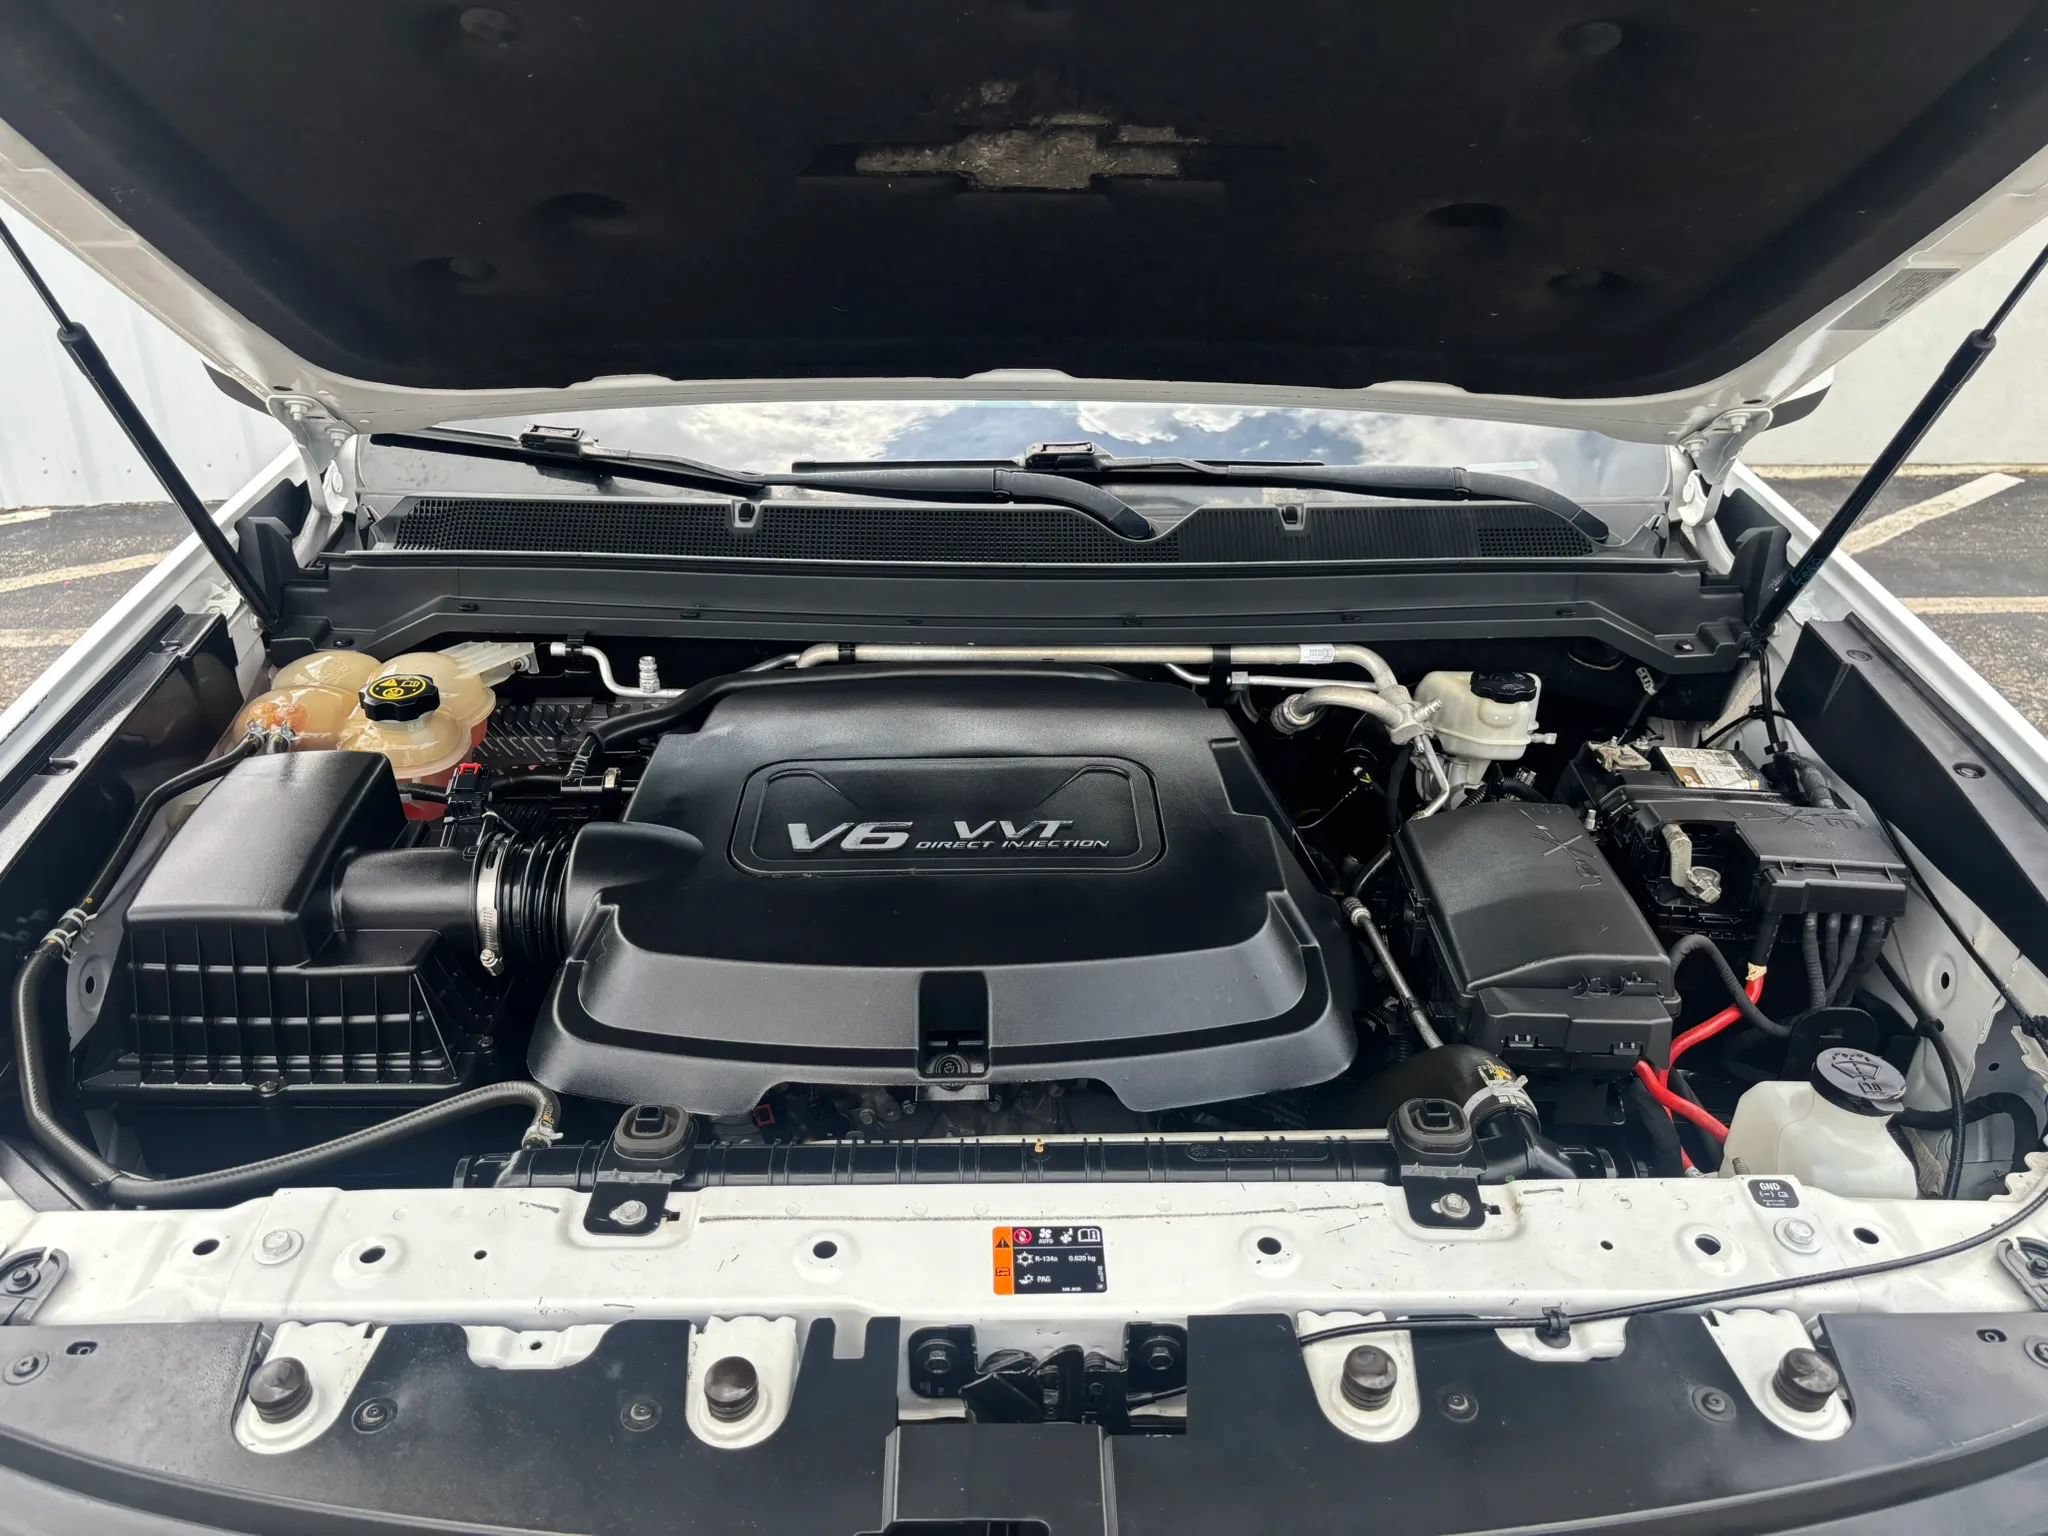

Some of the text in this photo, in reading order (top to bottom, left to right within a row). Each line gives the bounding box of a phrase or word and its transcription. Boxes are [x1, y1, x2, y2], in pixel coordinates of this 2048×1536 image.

[787, 820, 1074, 851] V6 VVT
[914, 839, 1110, 849] DIRECT INJECTION
[1759, 1182, 1780, 1190] GND
[1087, 1255, 1096, 1263] kg
[1037, 1275, 1051, 1283] PAG
